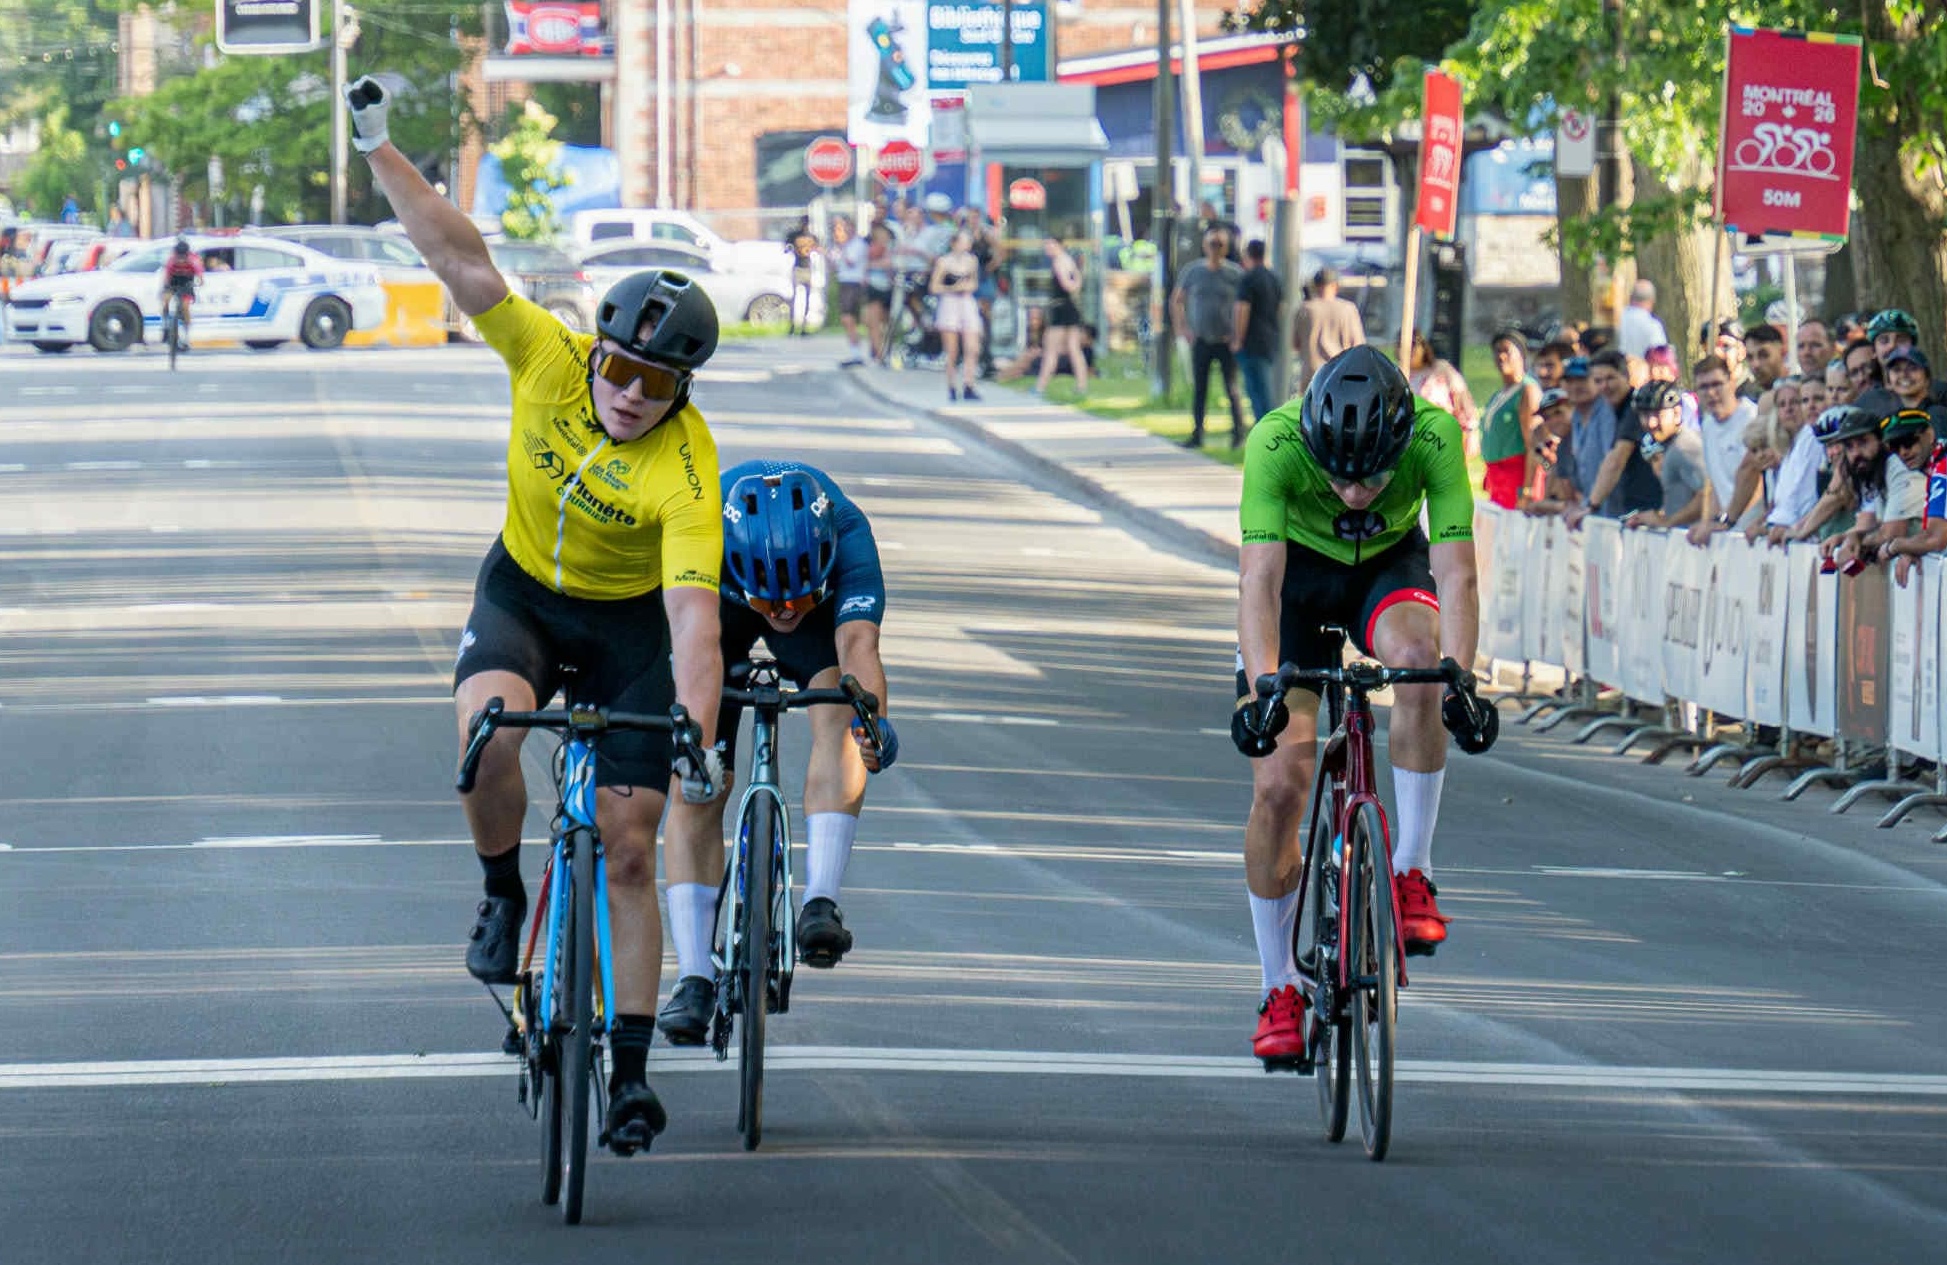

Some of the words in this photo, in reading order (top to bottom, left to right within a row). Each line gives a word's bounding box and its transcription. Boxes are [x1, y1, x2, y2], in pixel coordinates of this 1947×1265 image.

[1743, 85, 1833, 107] MONTRÉAL
[1742, 99, 1765, 117] 20
[1763, 188, 1801, 207] 50M
[679, 443, 704, 500] UNION
[562, 471, 637, 526] Planète
